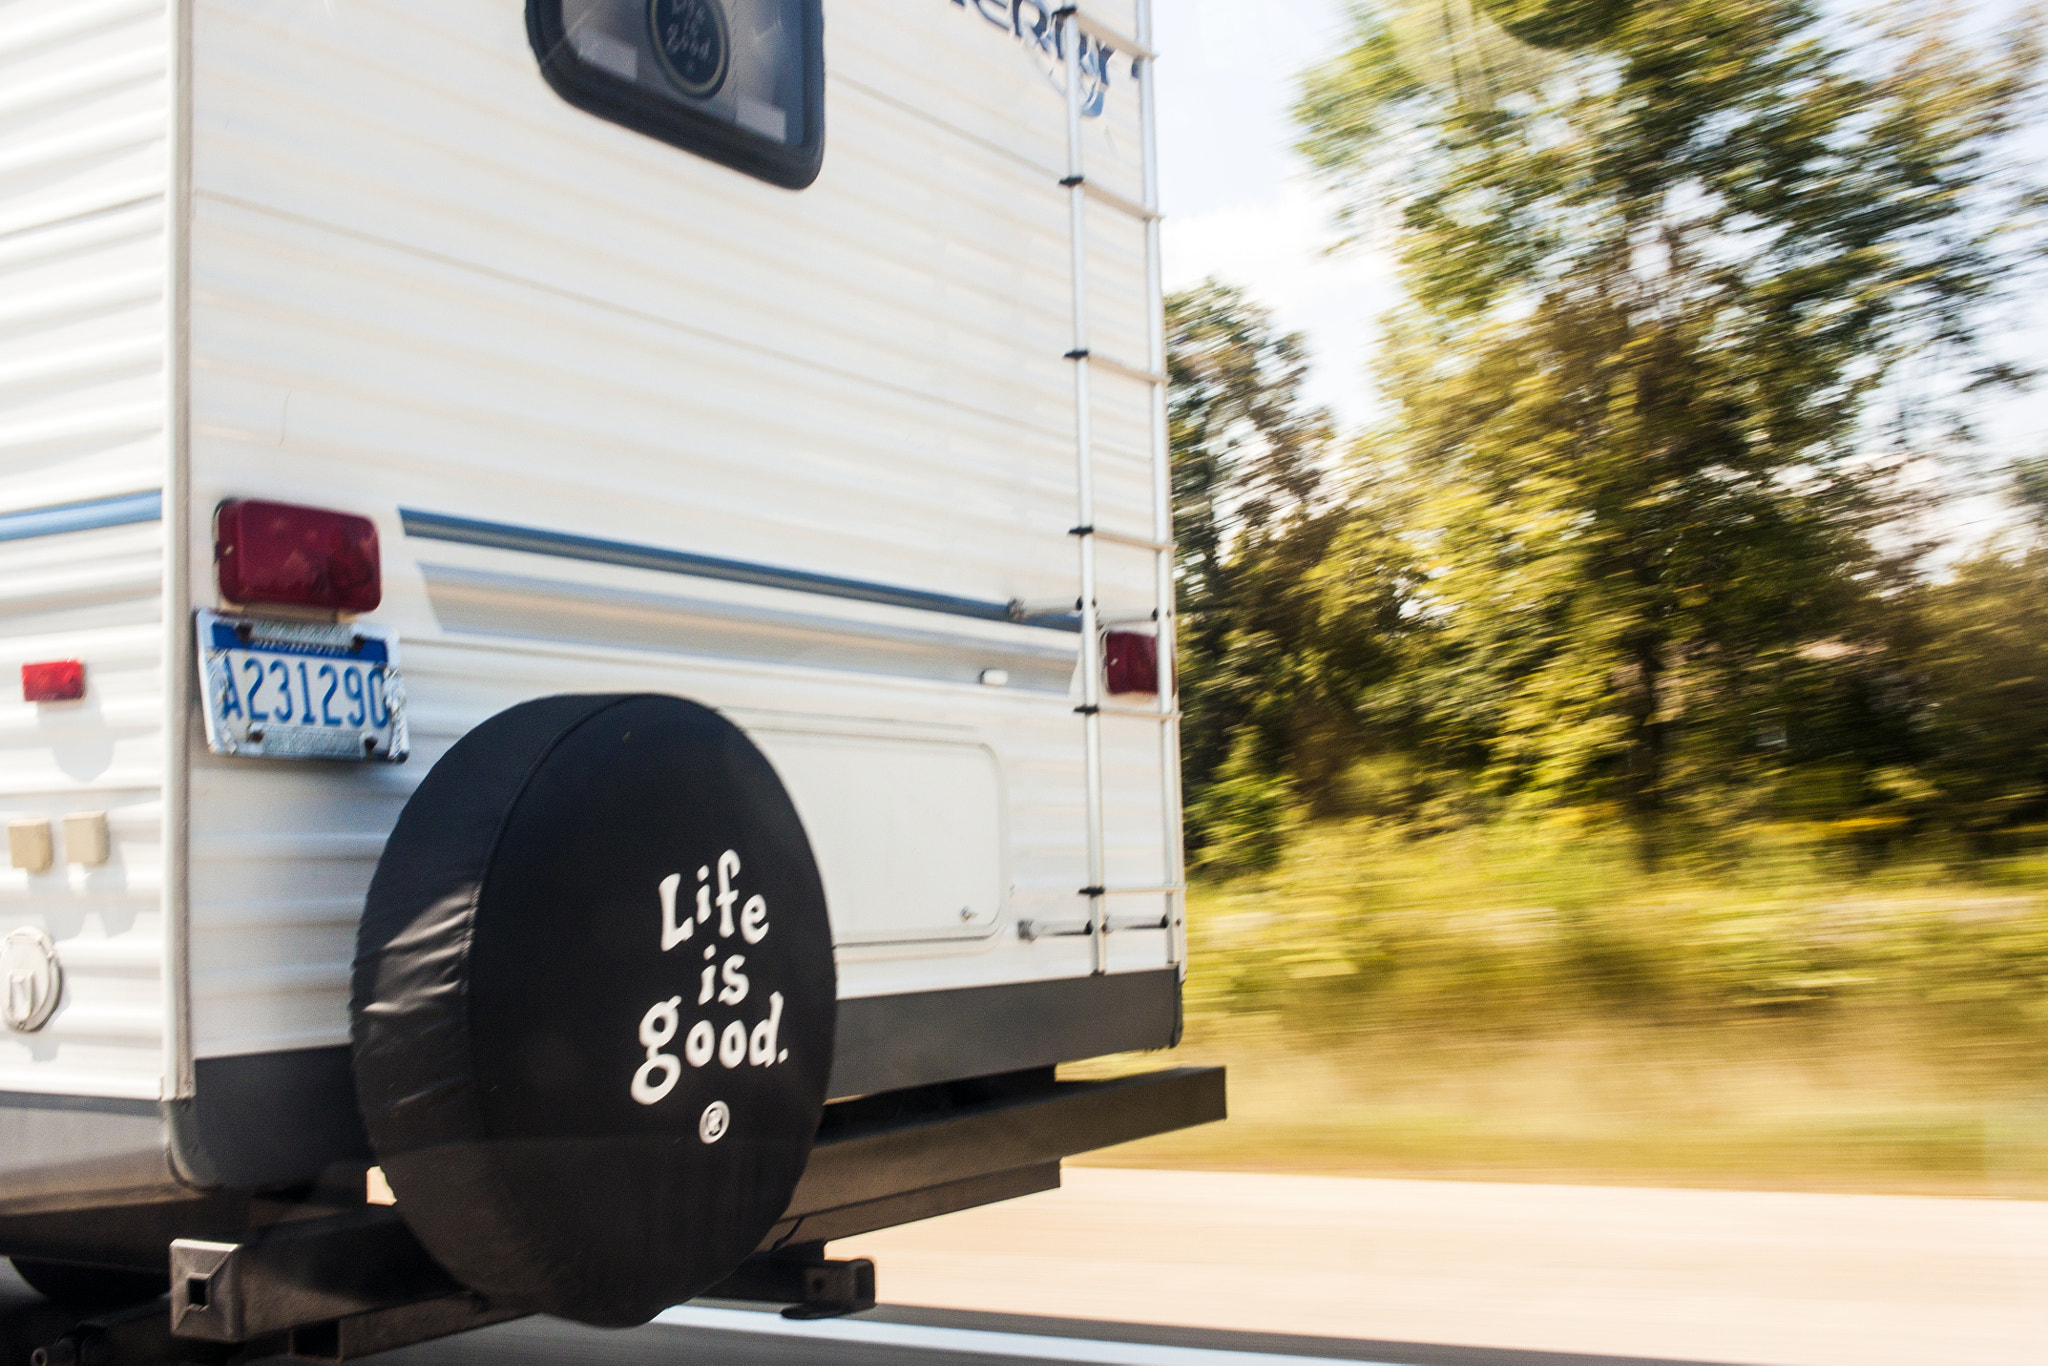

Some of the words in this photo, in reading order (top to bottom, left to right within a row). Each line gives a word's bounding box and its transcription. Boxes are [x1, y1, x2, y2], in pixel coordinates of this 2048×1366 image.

[222, 656, 388, 729] A231290
[659, 849, 769, 951] Life
[698, 944, 749, 1005] is
[631, 991, 788, 1105] good.
